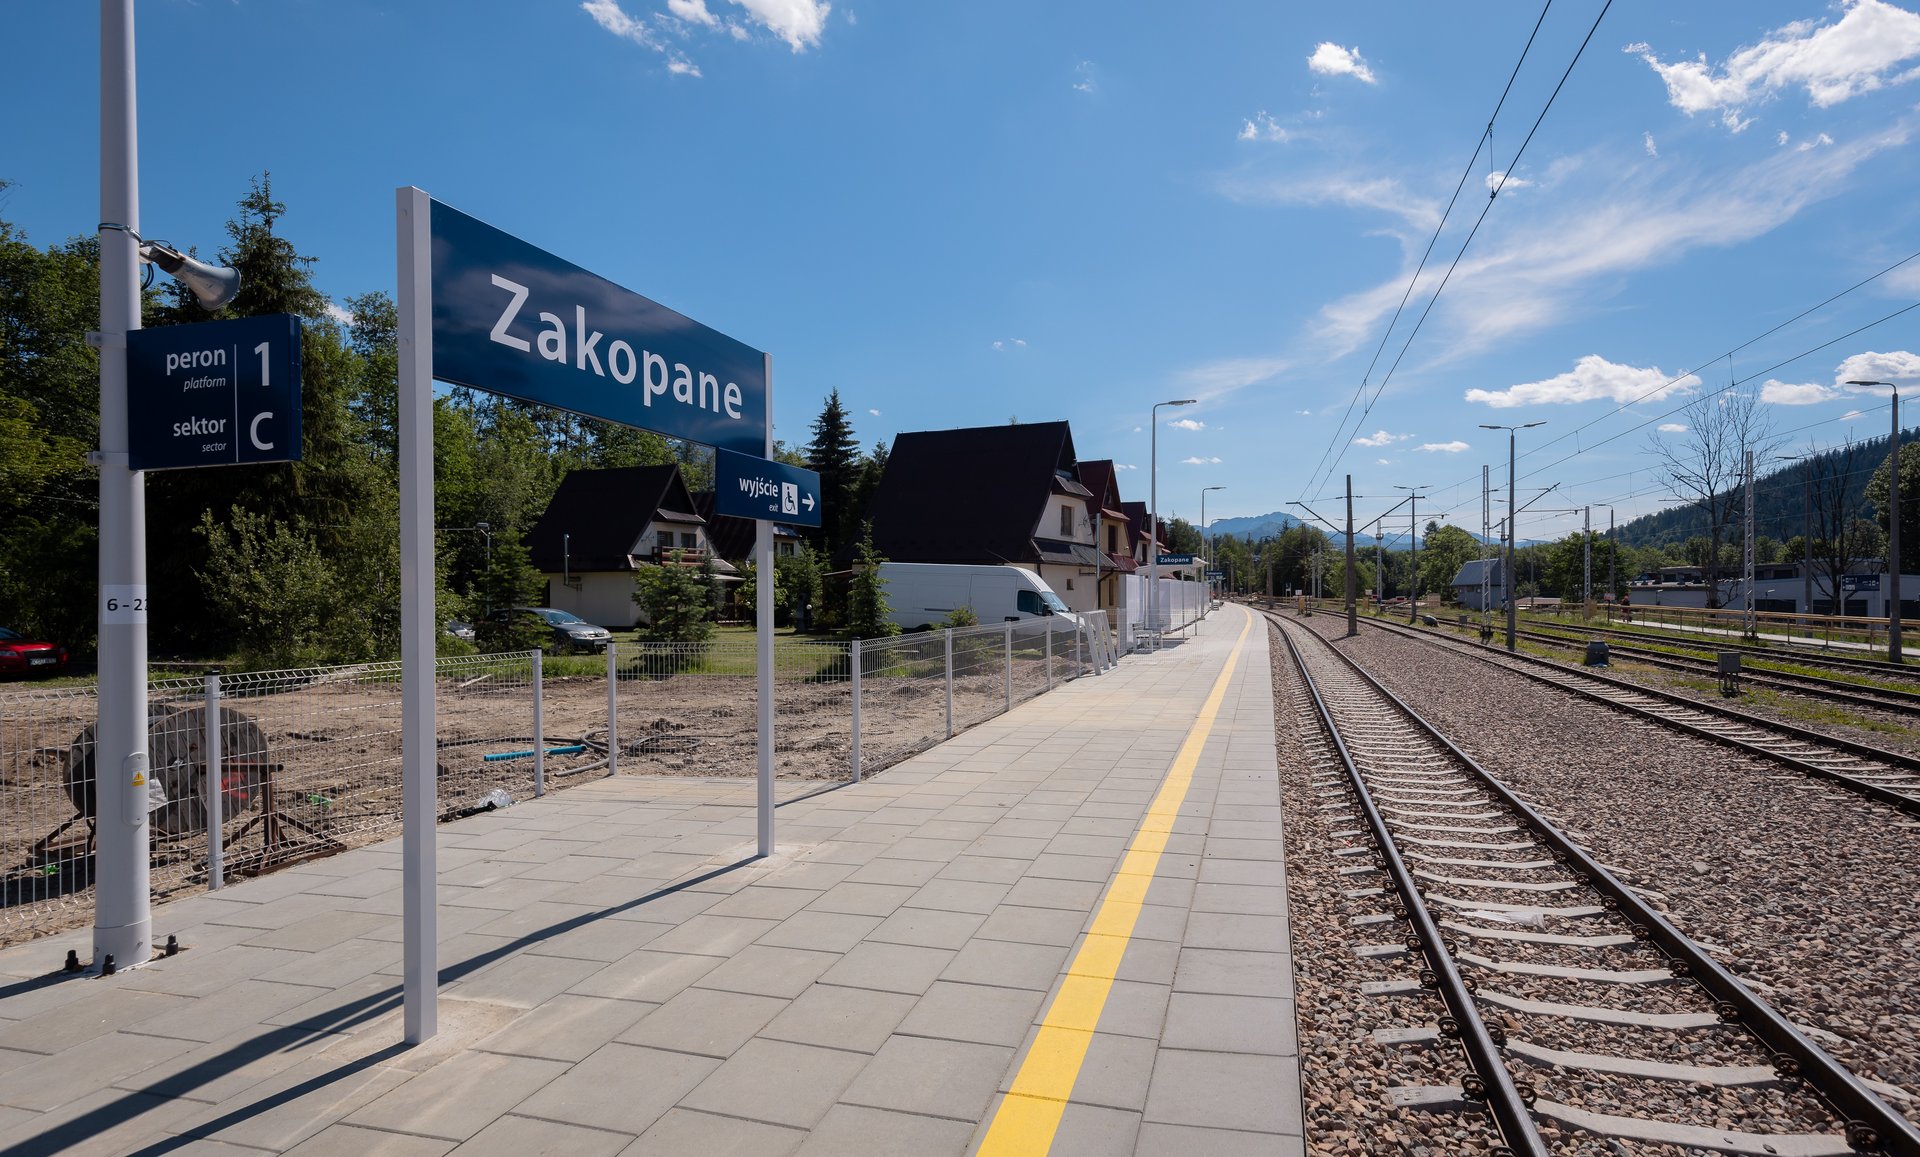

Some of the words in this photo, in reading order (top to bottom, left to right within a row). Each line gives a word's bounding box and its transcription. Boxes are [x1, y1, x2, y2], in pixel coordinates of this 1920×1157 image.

[490, 273, 742, 419] Zakopane
[166, 348, 226, 376] peron
[254, 341, 270, 386] 1
[183, 375, 226, 392] platform
[173, 416, 226, 437] sektor
[250, 411, 274, 450] C
[202, 442, 227, 452] sector
[739, 476, 779, 498] wyjście
[768, 503, 779, 512] exit
